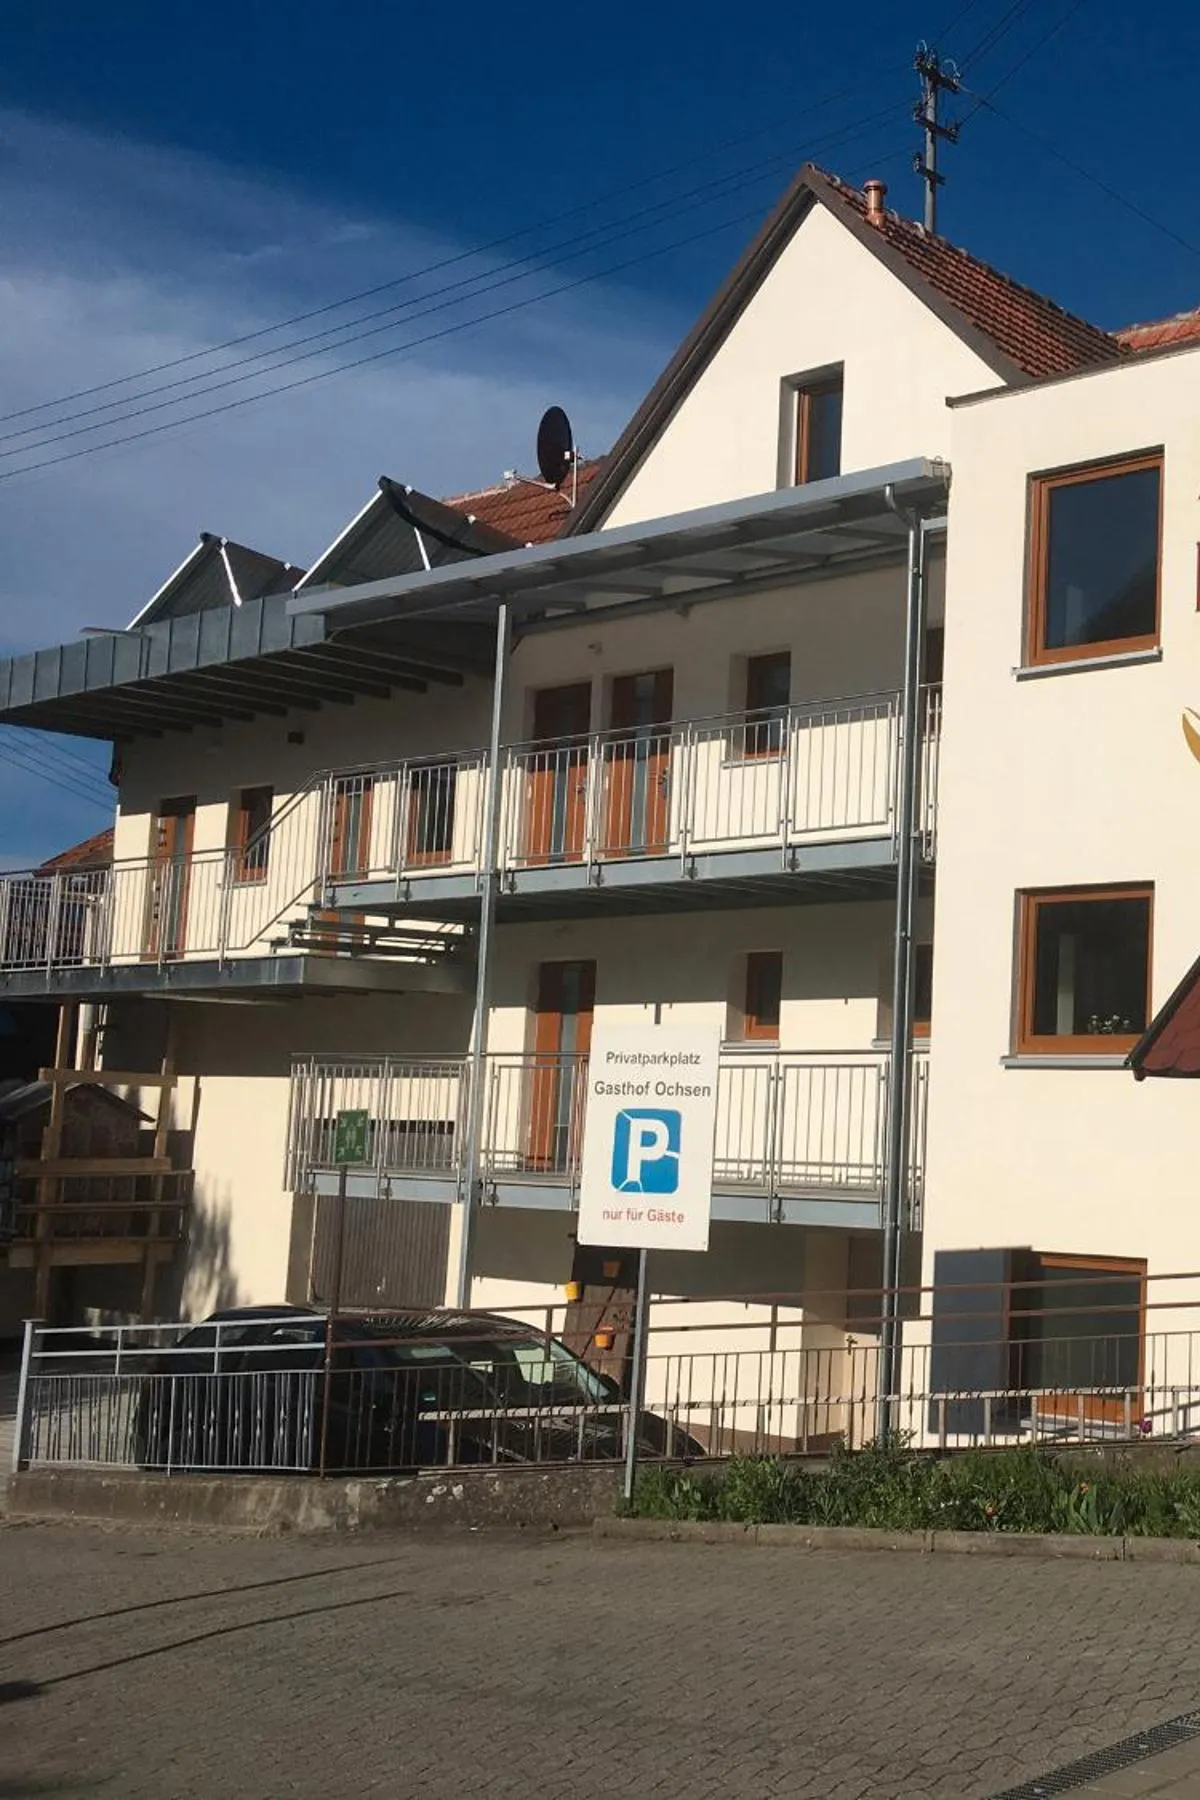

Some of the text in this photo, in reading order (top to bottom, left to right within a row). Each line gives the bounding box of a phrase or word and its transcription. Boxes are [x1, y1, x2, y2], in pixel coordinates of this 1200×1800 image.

[605, 1051, 701, 1067] Privatparkplatz
[594, 1080, 711, 1098] Gasthof Ochsen
[627, 1118, 670, 1182] P
[602, 1207, 685, 1224] nur für Gäste
